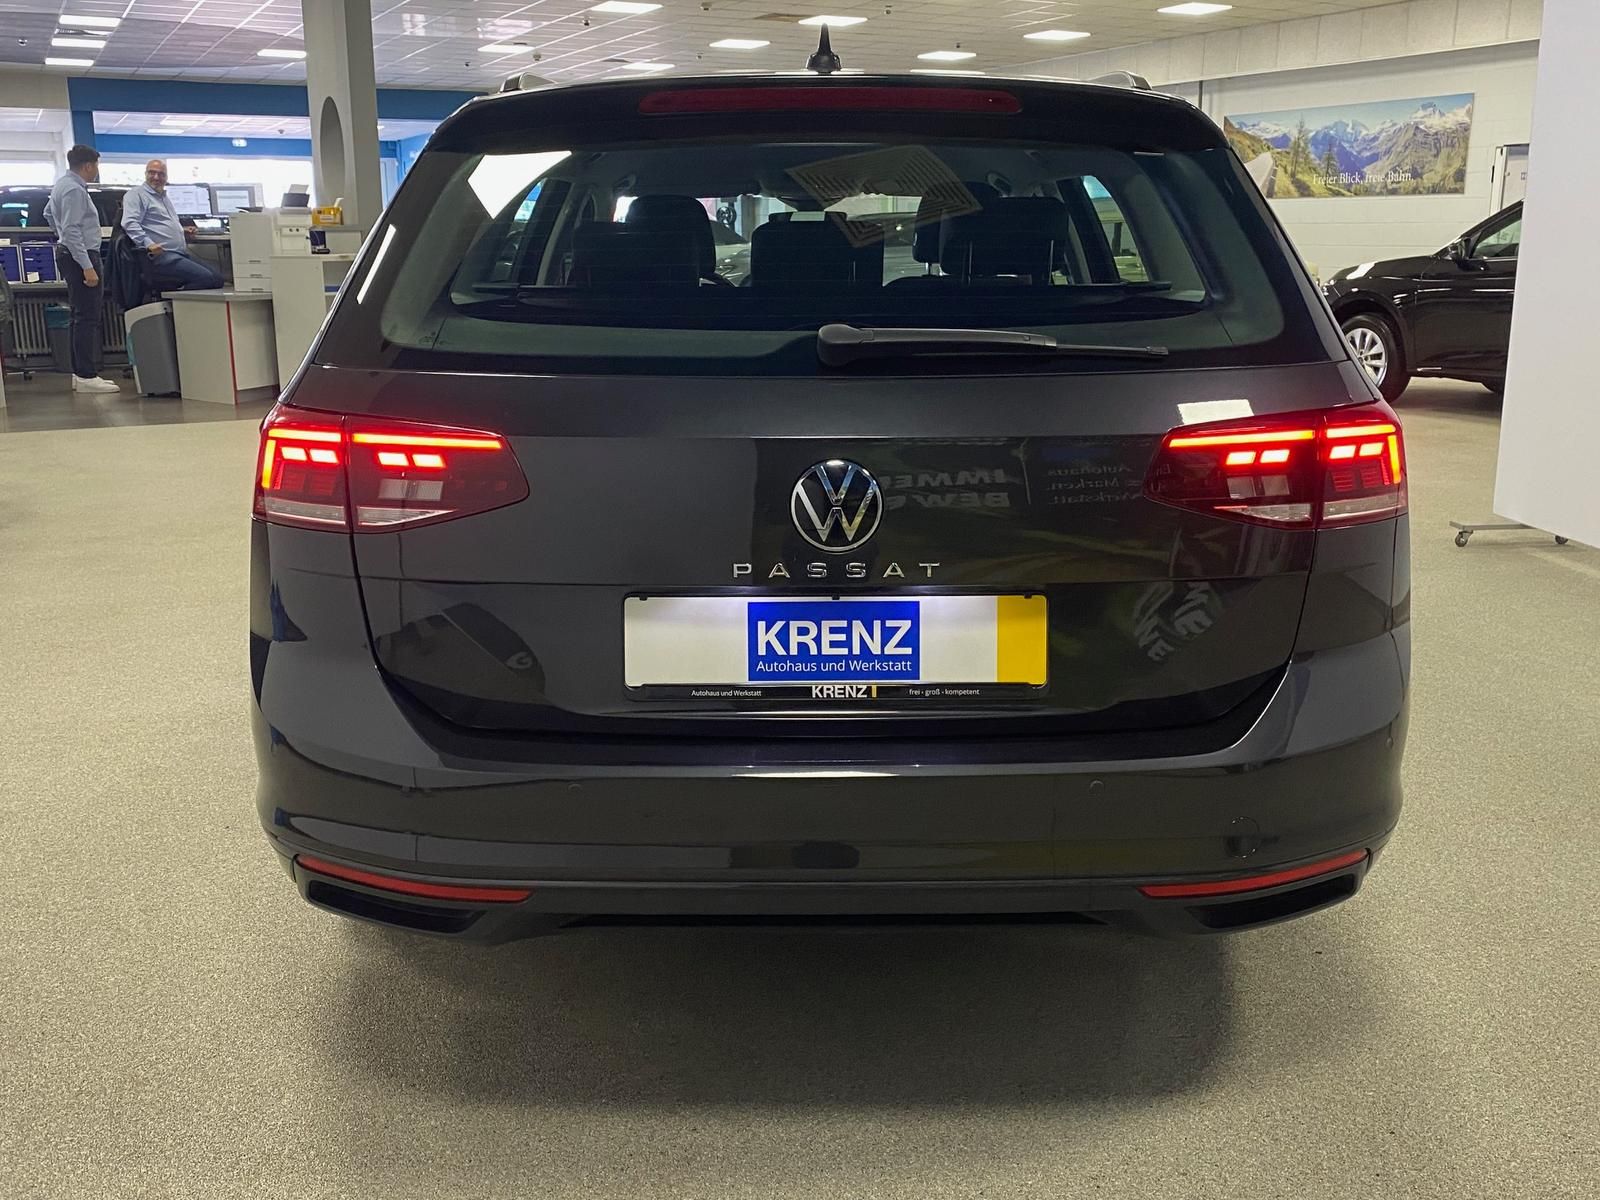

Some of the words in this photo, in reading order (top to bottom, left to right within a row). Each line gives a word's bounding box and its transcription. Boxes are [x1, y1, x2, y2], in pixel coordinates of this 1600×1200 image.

[1313, 173, 1337, 185] Freier
[1340, 171, 1363, 185] Blick,
[1365, 172, 1386, 183] freie
[733, 562, 940, 578] PASSAT
[757, 620, 913, 656] KRENZ
[756, 660, 817, 672] Autohaus
[820, 660, 845, 672] und
[849, 660, 912, 672] Werkstatt
[691, 689, 720, 697] Autohaus
[720, 689, 733, 697] und
[733, 689, 762, 697] Werkstatt
[811, 685, 867, 698] KRENZ
[909, 688, 921, 696] frei
[925, 688, 941, 698] groß
[944, 688, 980, 697] kompetent
